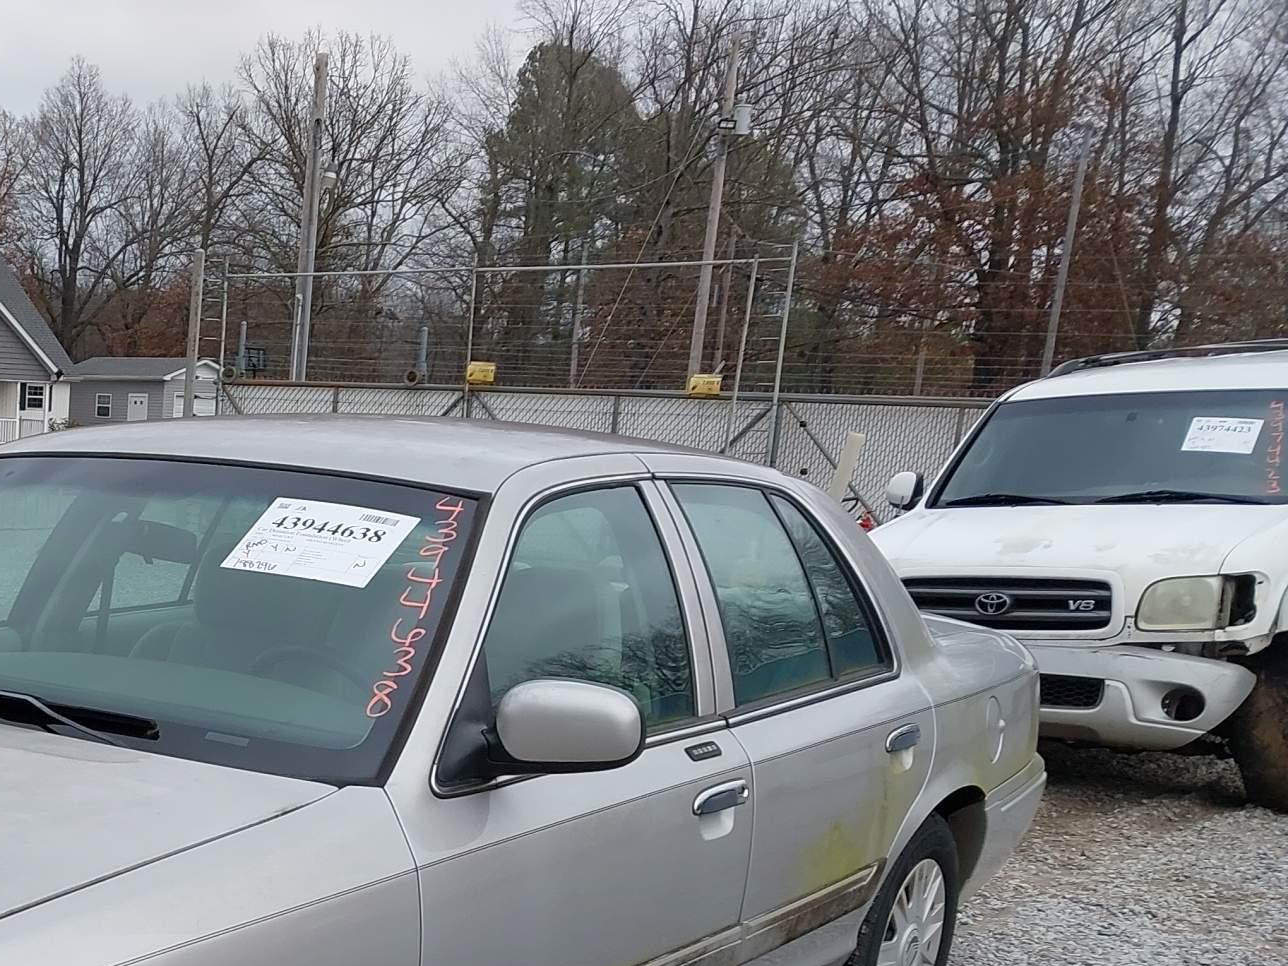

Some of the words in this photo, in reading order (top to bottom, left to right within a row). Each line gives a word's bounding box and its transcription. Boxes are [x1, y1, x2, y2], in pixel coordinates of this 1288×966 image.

[271, 515, 387, 543] 43944638
[365, 496, 464, 718] 43944638
[1068, 600, 1096, 611] V8
